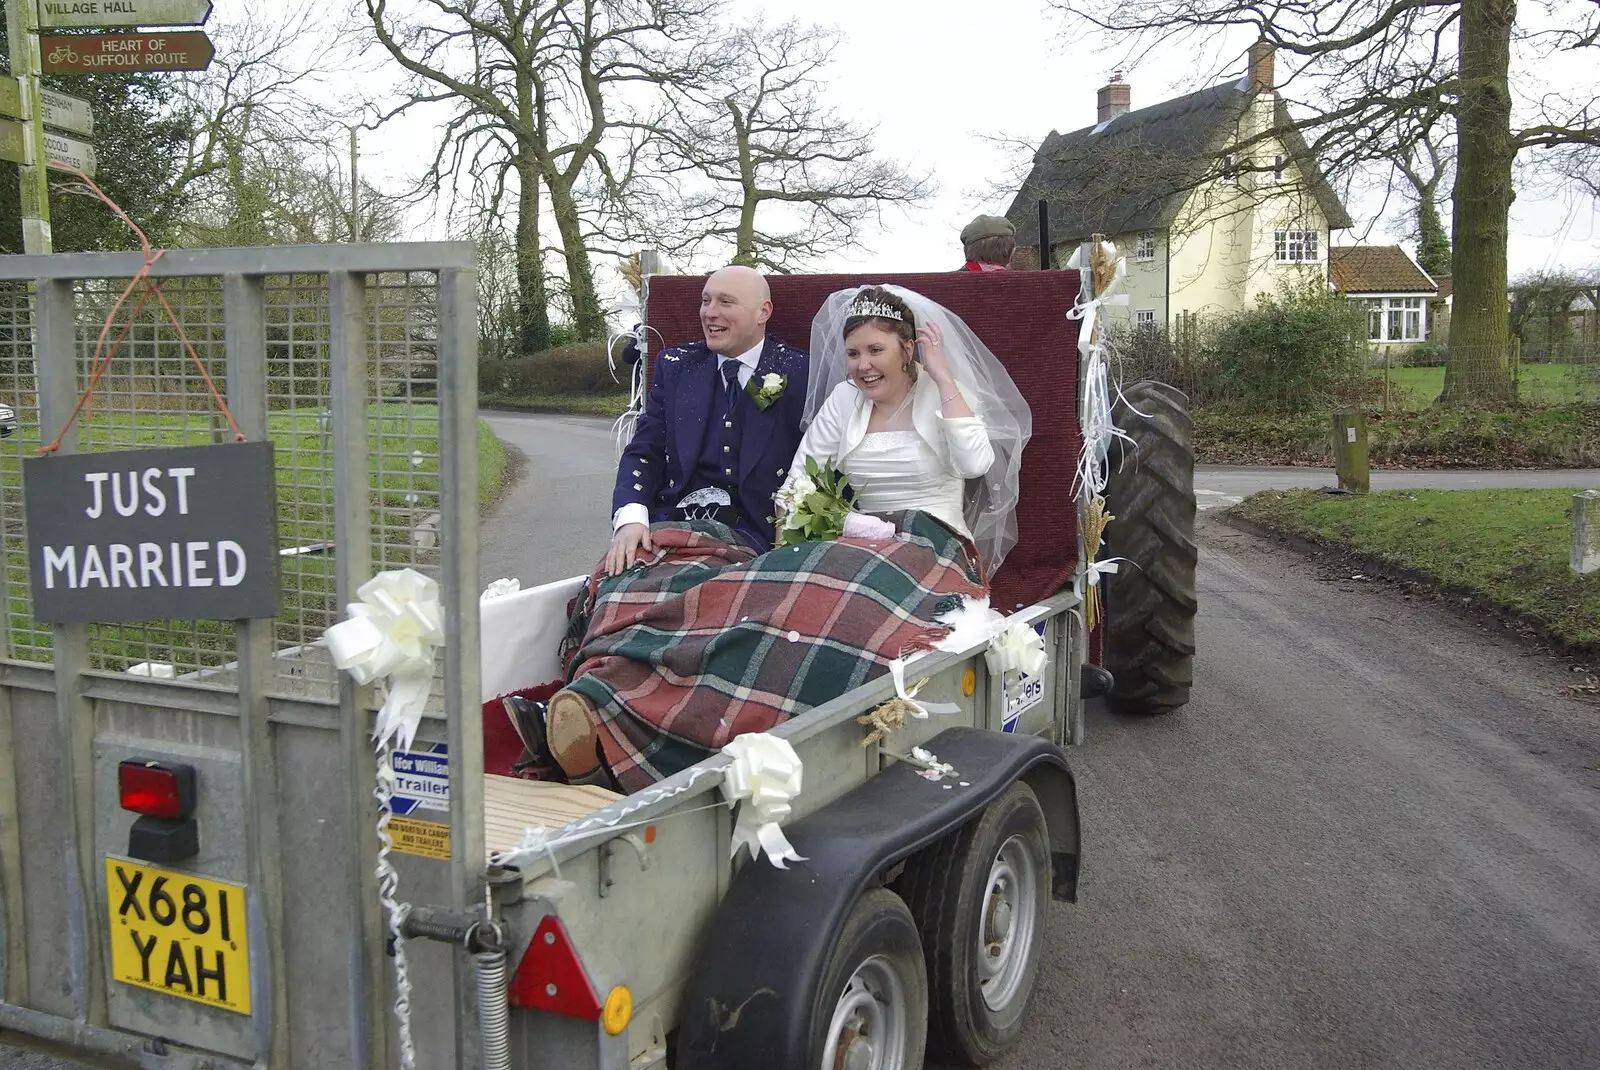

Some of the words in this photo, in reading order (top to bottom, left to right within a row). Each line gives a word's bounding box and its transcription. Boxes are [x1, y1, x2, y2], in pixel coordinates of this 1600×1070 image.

[45, 3, 98, 14] VILLAGE
[104, 1, 137, 13] HALL
[83, 54, 140, 67] SUFFOLK
[145, 52, 188, 64] ROUTE
[101, 39, 143, 51] HEART
[148, 39, 166, 51] OF
[85, 467, 195, 519] JUST
[43, 540, 247, 589] MARRIED
[115, 866, 231, 942] X681
[130, 929, 227, 1001] YAH
